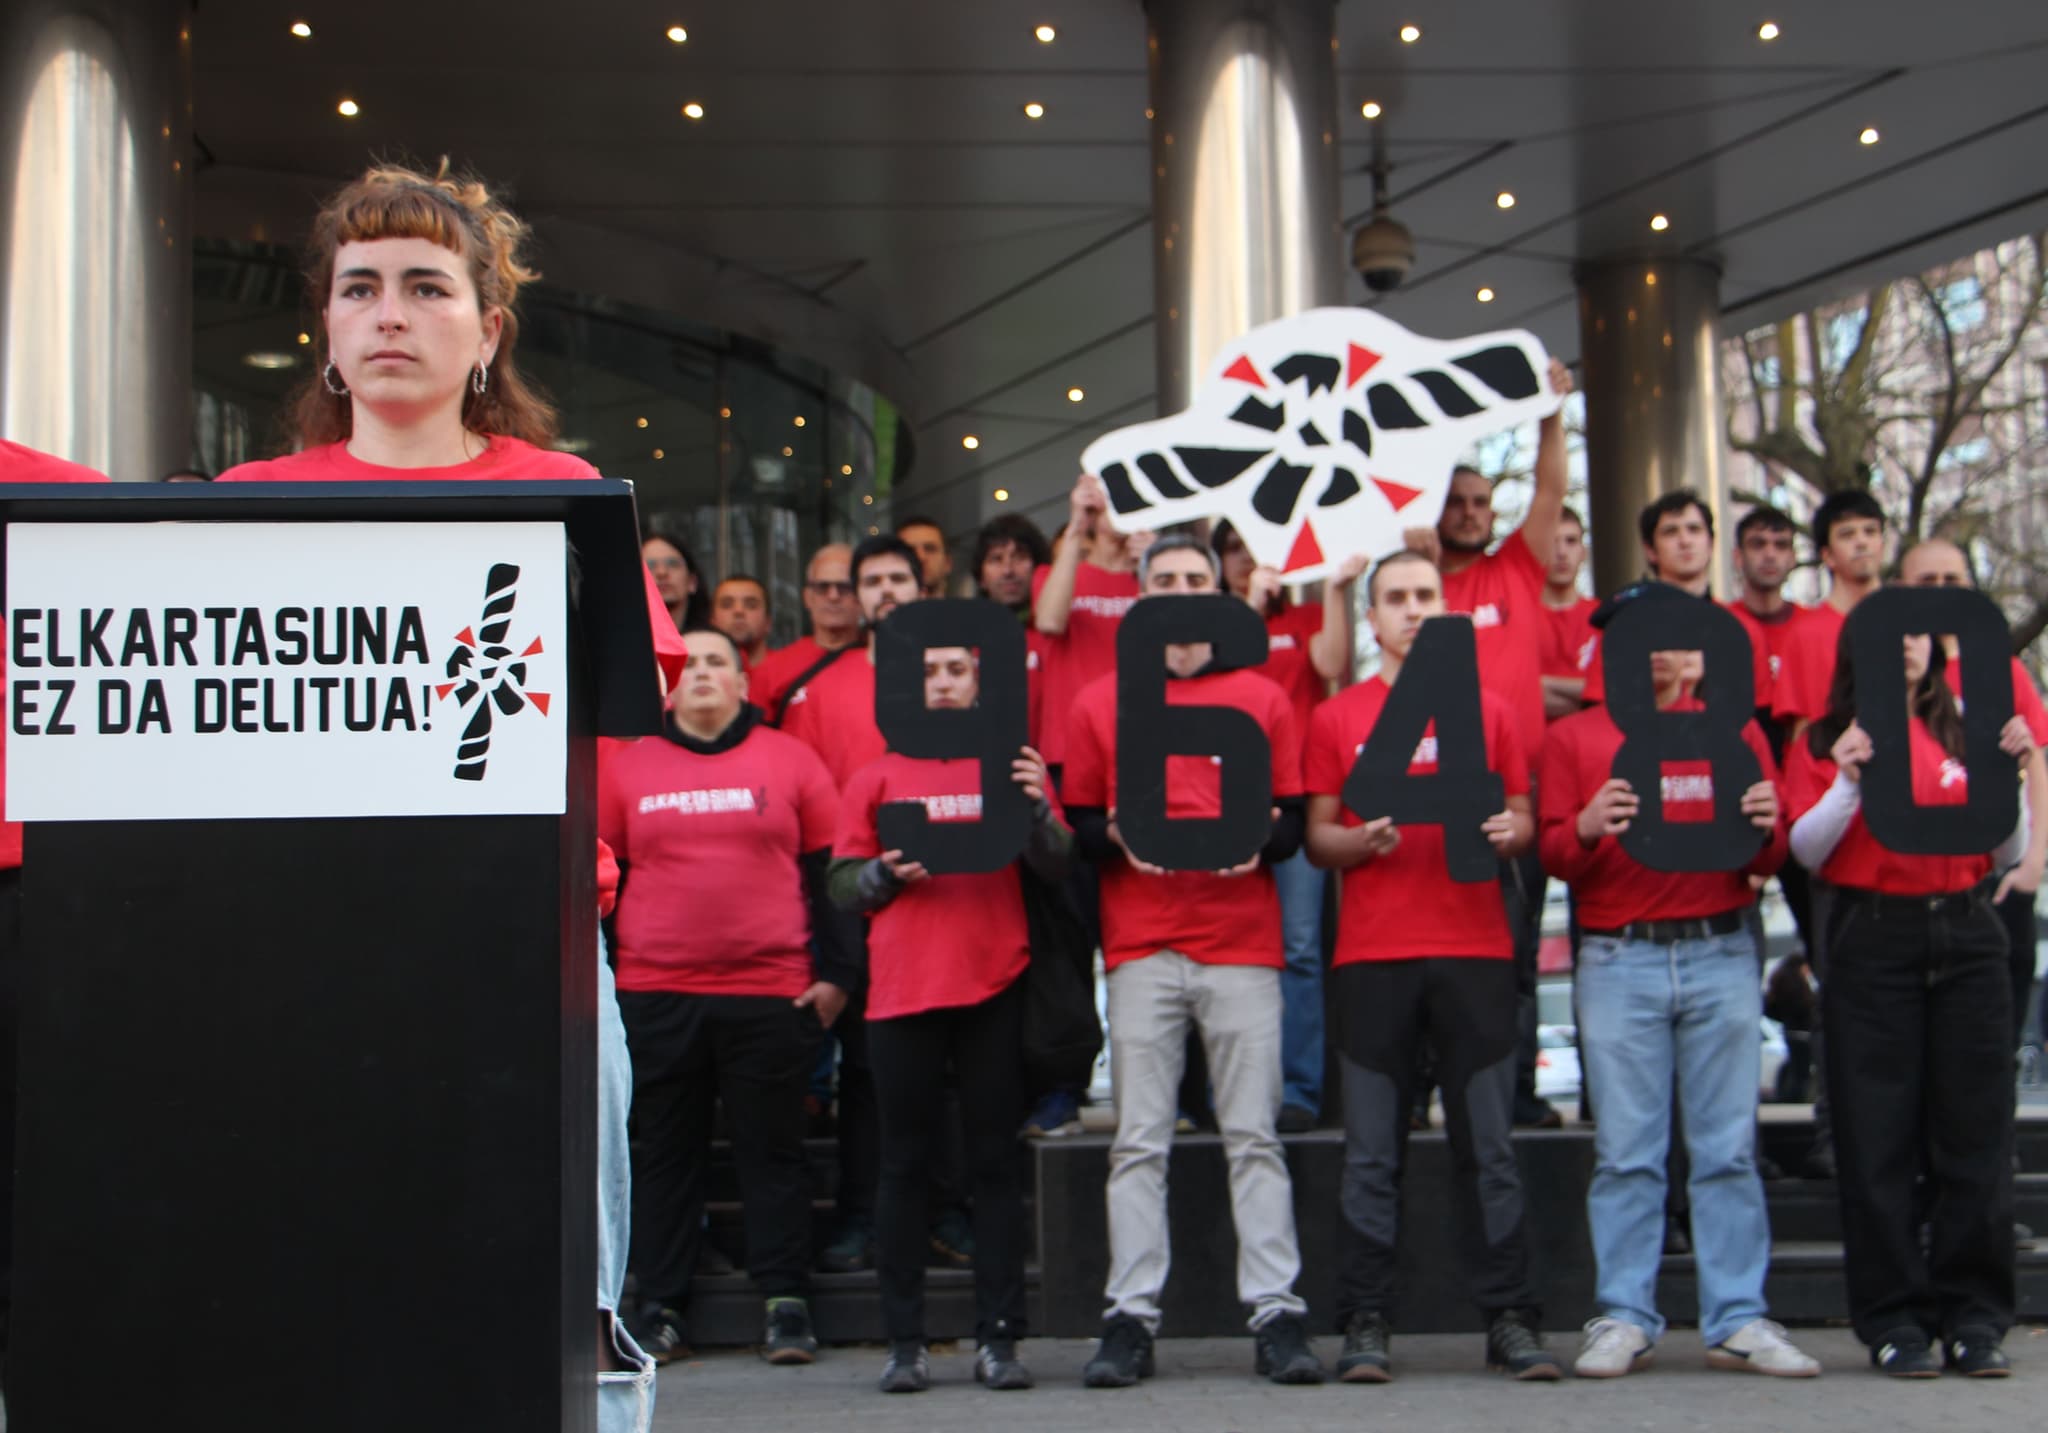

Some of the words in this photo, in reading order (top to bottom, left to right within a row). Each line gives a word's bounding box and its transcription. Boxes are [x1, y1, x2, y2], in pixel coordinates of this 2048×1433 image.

[13, 607, 429, 667] ELKARTASUNA
[13, 680, 75, 735] EZ
[99, 679, 171, 734] DA
[195, 677, 431, 733] DELITUA!
[875, 598, 1028, 874] 9
[1116, 594, 1272, 871] 6
[1342, 616, 1507, 883] 4
[1604, 584, 1764, 872] 8
[1844, 586, 2021, 856] 0
